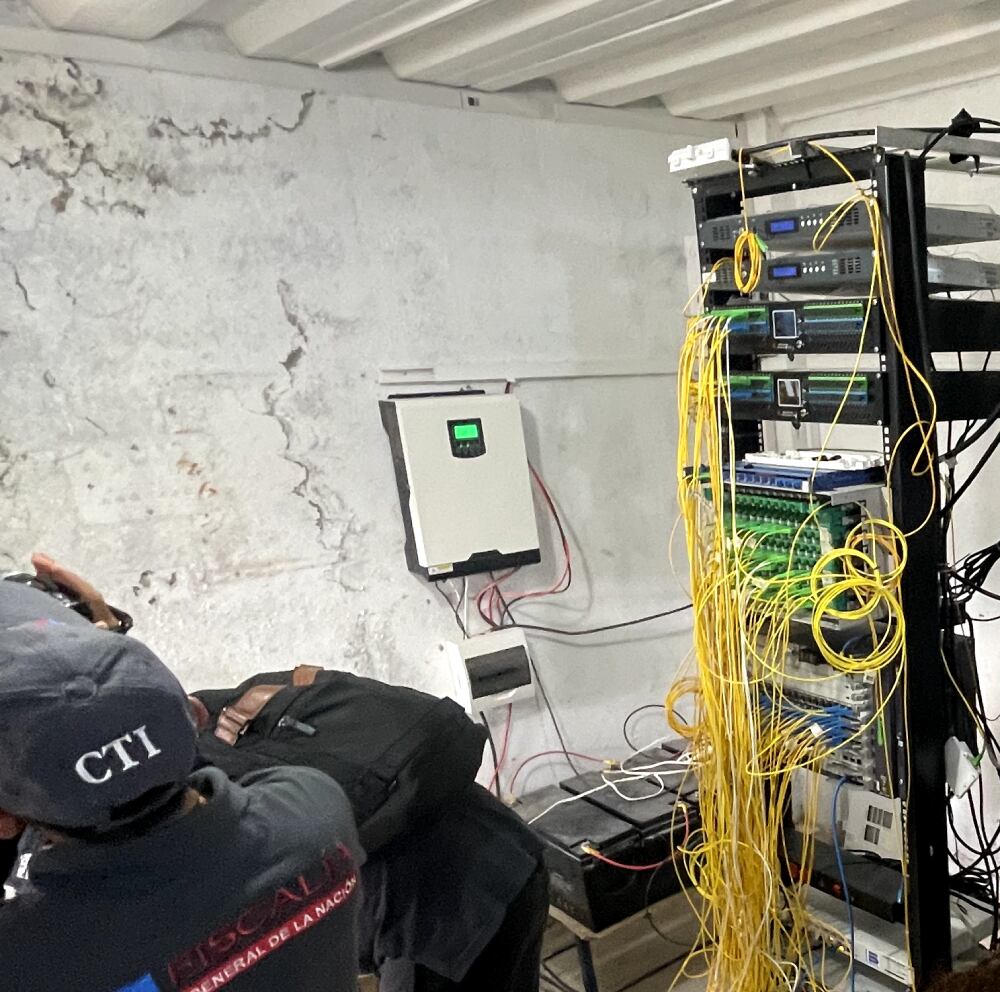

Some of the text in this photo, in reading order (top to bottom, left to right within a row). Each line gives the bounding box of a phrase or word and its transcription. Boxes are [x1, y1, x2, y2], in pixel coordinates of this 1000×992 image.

[75, 724, 161, 784] CTI
[268, 925, 291, 949] DE
[293, 912, 314, 932] LA
